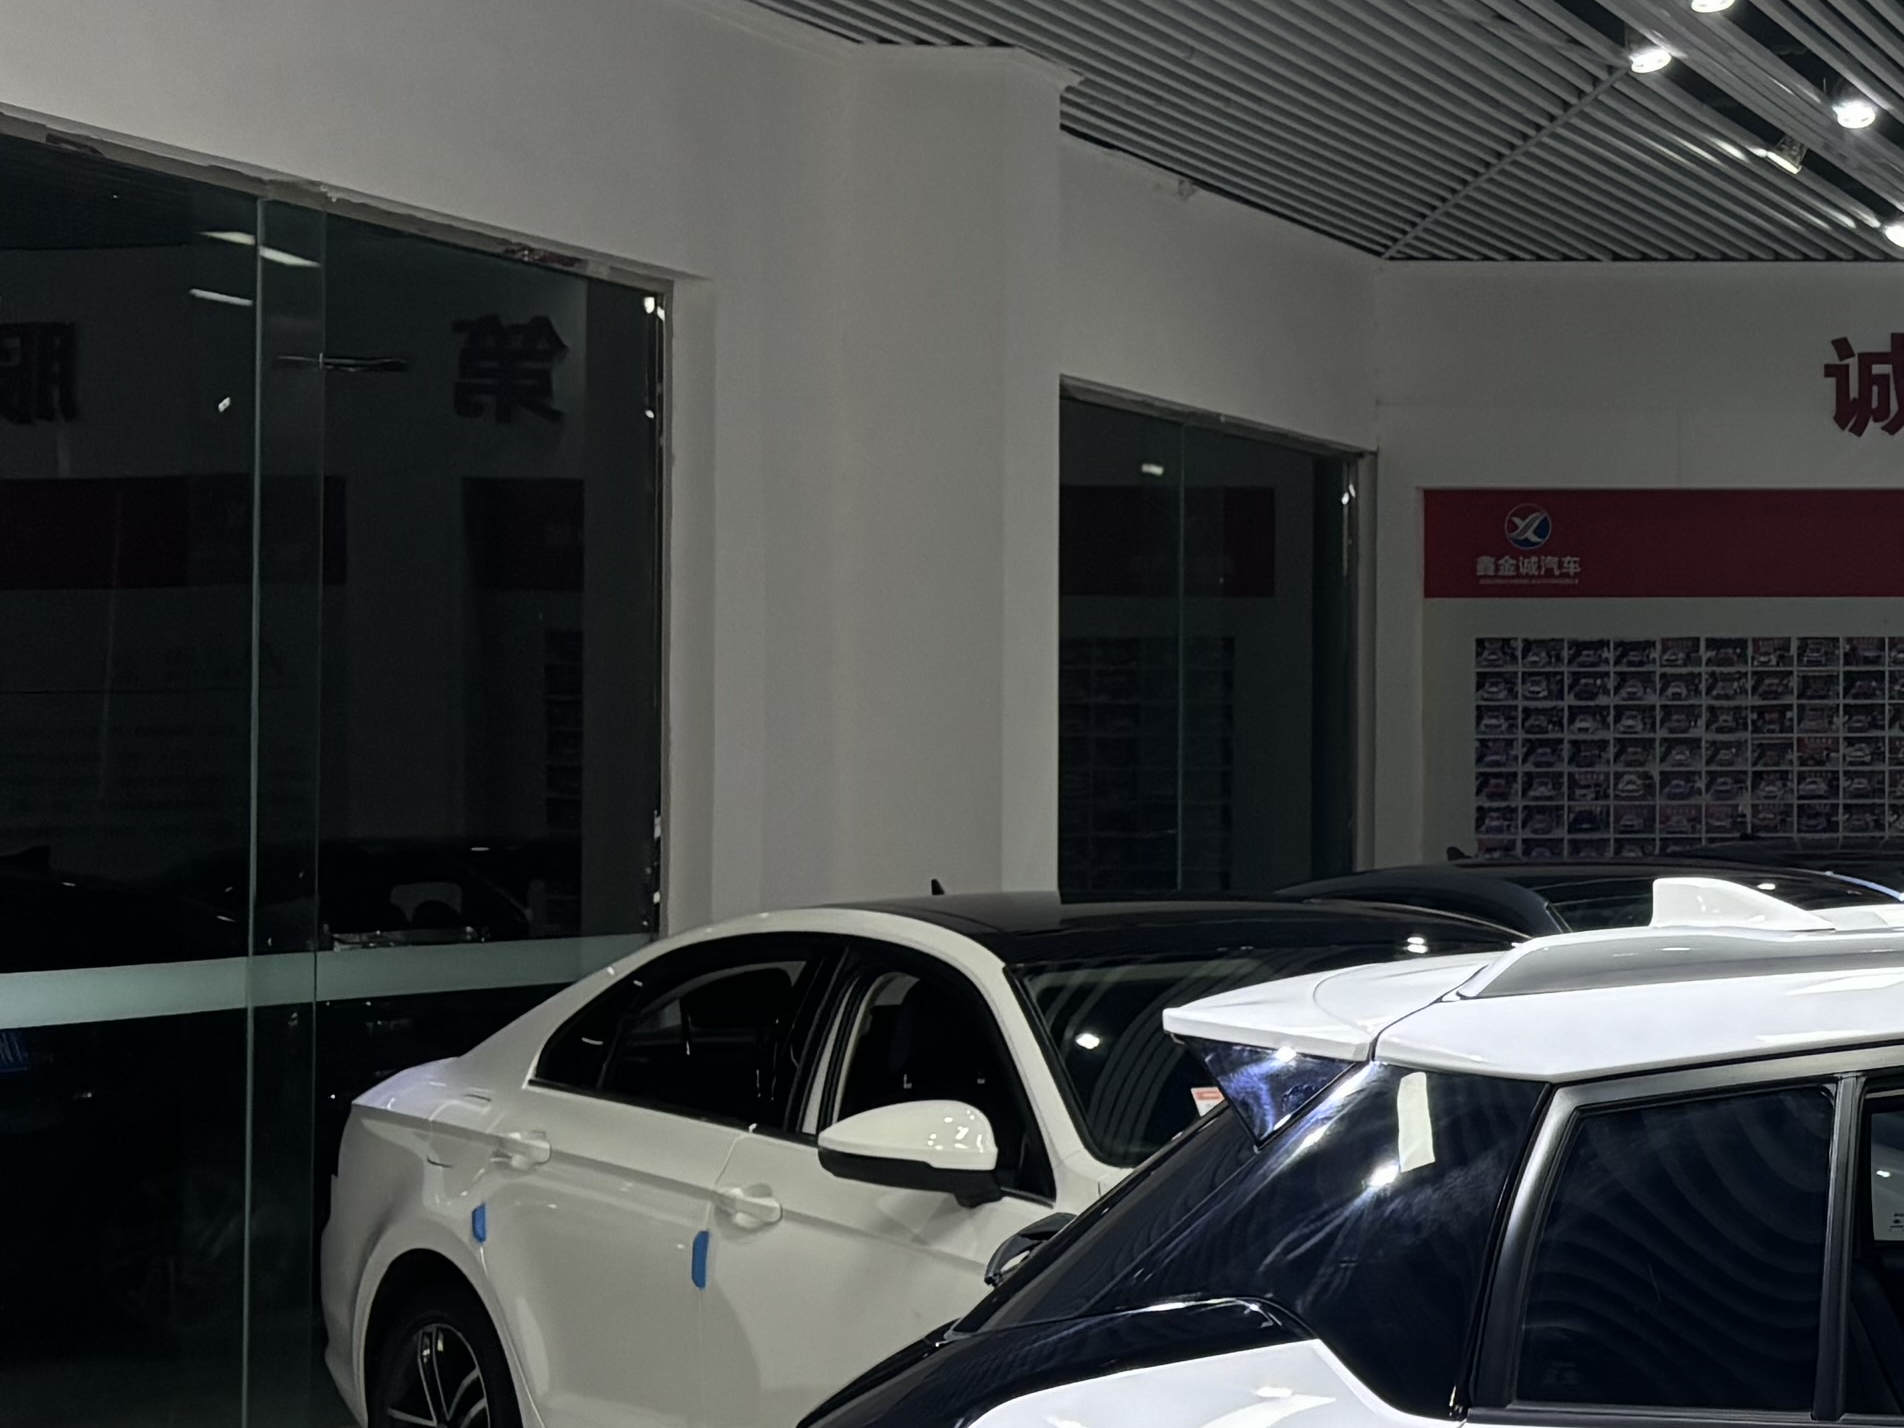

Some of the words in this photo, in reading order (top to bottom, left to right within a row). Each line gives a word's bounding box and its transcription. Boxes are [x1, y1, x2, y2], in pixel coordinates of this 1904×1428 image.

[1476, 555, 1582, 577] 鑫金诚汽车
